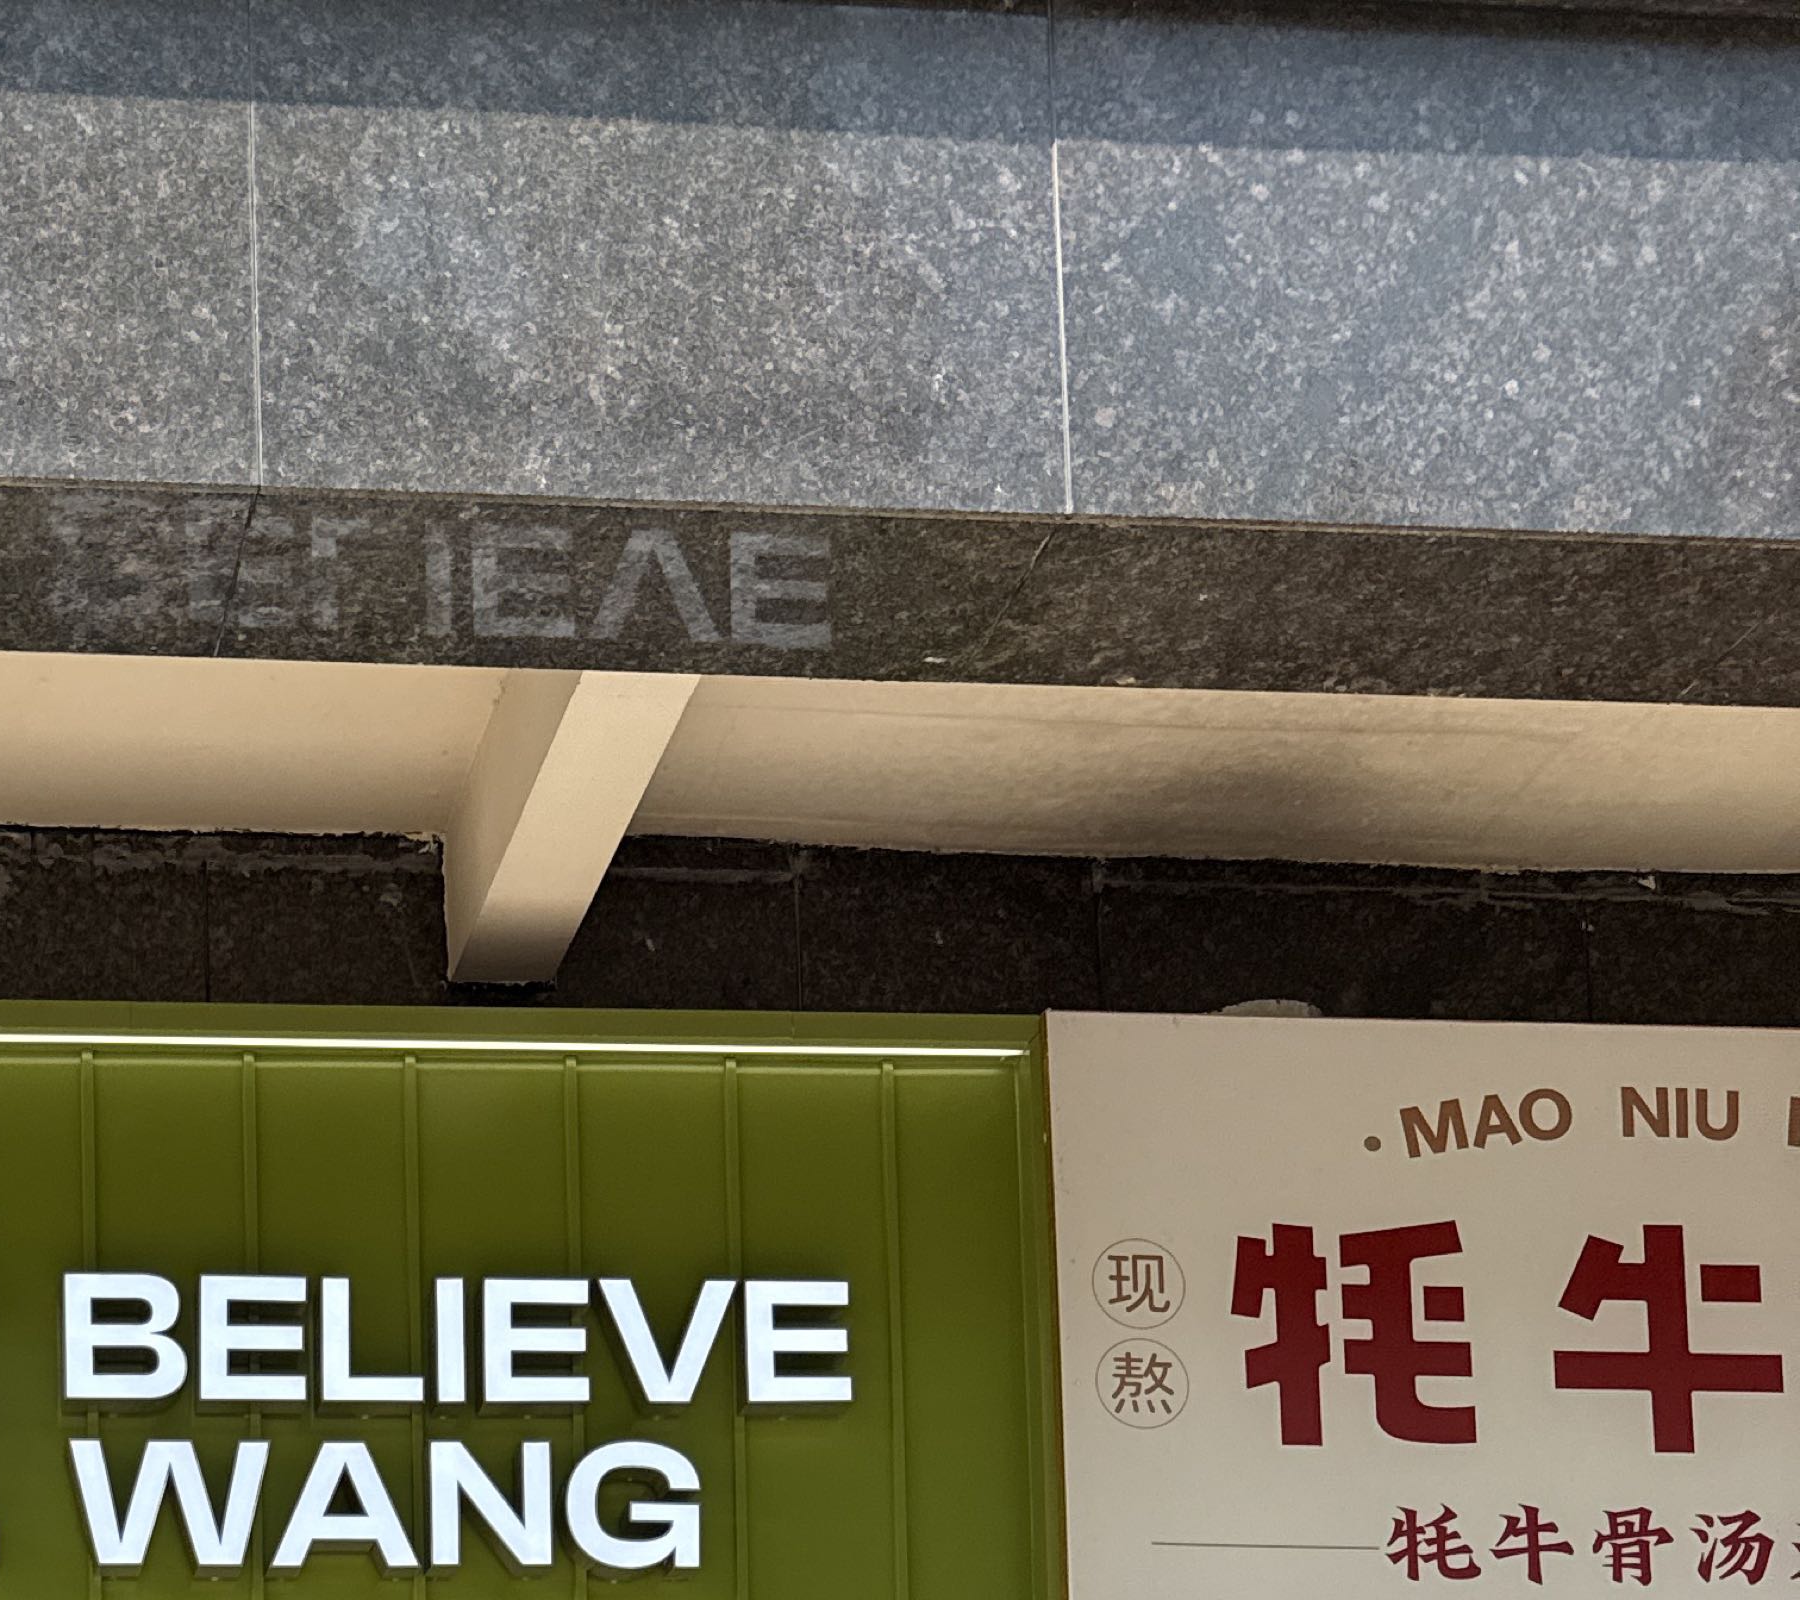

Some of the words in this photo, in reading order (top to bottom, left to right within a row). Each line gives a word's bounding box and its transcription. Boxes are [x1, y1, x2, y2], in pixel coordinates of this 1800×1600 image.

[1400, 1088, 1573, 1158] MAO
[1621, 1086, 1740, 1141] NIU
[61, 1271, 854, 1403] BELIEVE
[1230, 1220, 1783, 1455] 牦牛
[68, 1438, 702, 1570] WANG
[1386, 1503, 1800, 1586] 牦牛骨汤
